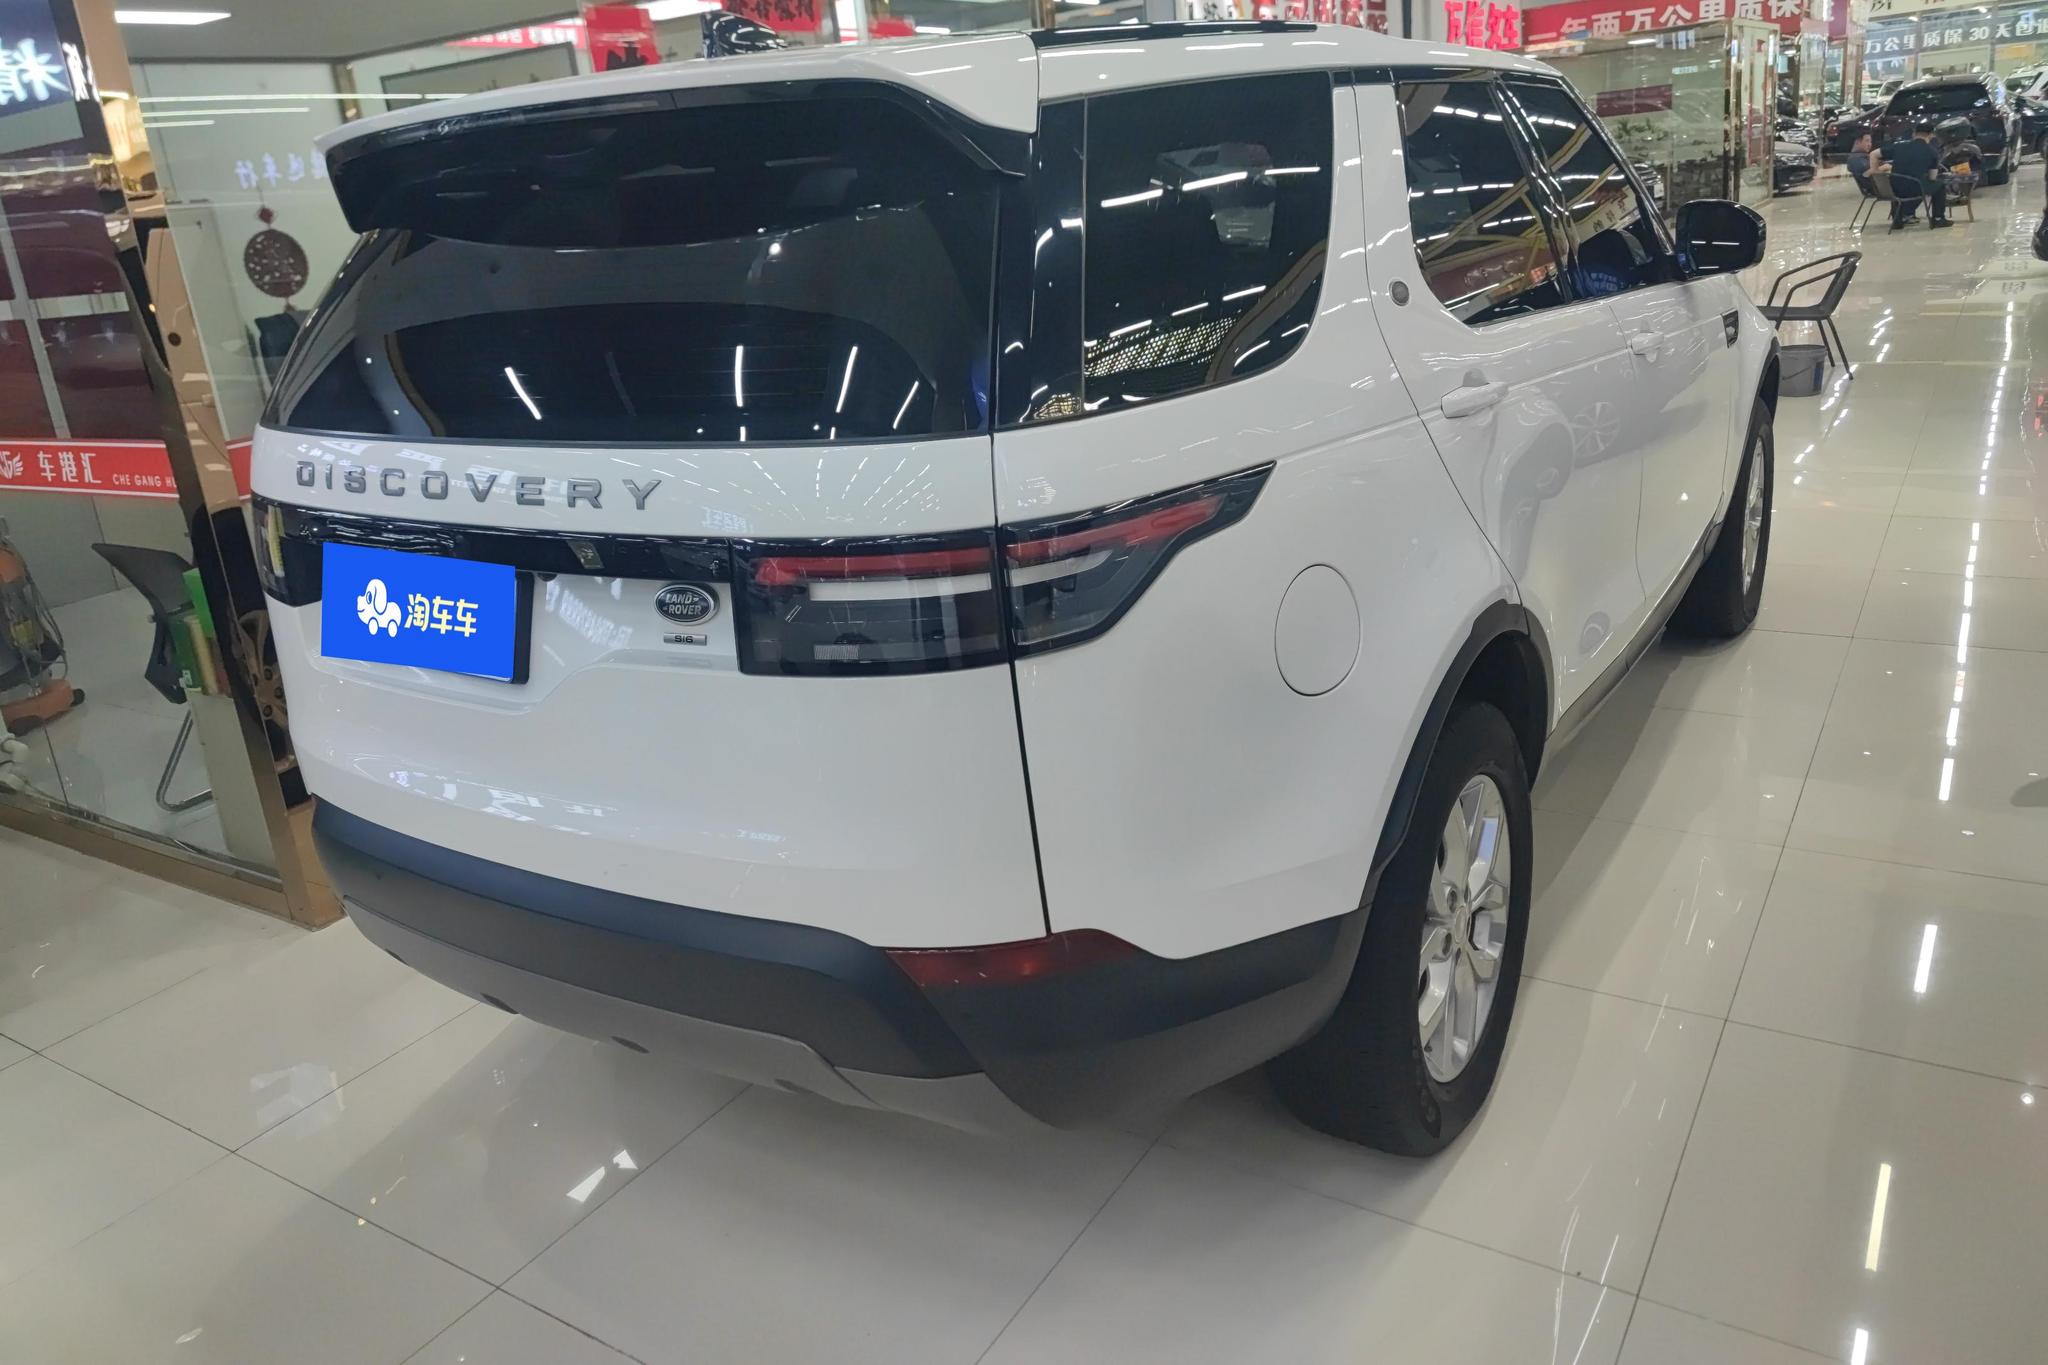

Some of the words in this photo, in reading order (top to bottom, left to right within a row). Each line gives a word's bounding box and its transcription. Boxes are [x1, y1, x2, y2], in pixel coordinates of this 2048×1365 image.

[37, 450, 102, 484] 车港汇
[112, 473, 131, 486] CHE
[134, 474, 161, 487] GANG
[296, 460, 662, 511] DISCOVERY
[665, 593, 692, 604] LAND
[668, 604, 702, 615] ROVER
